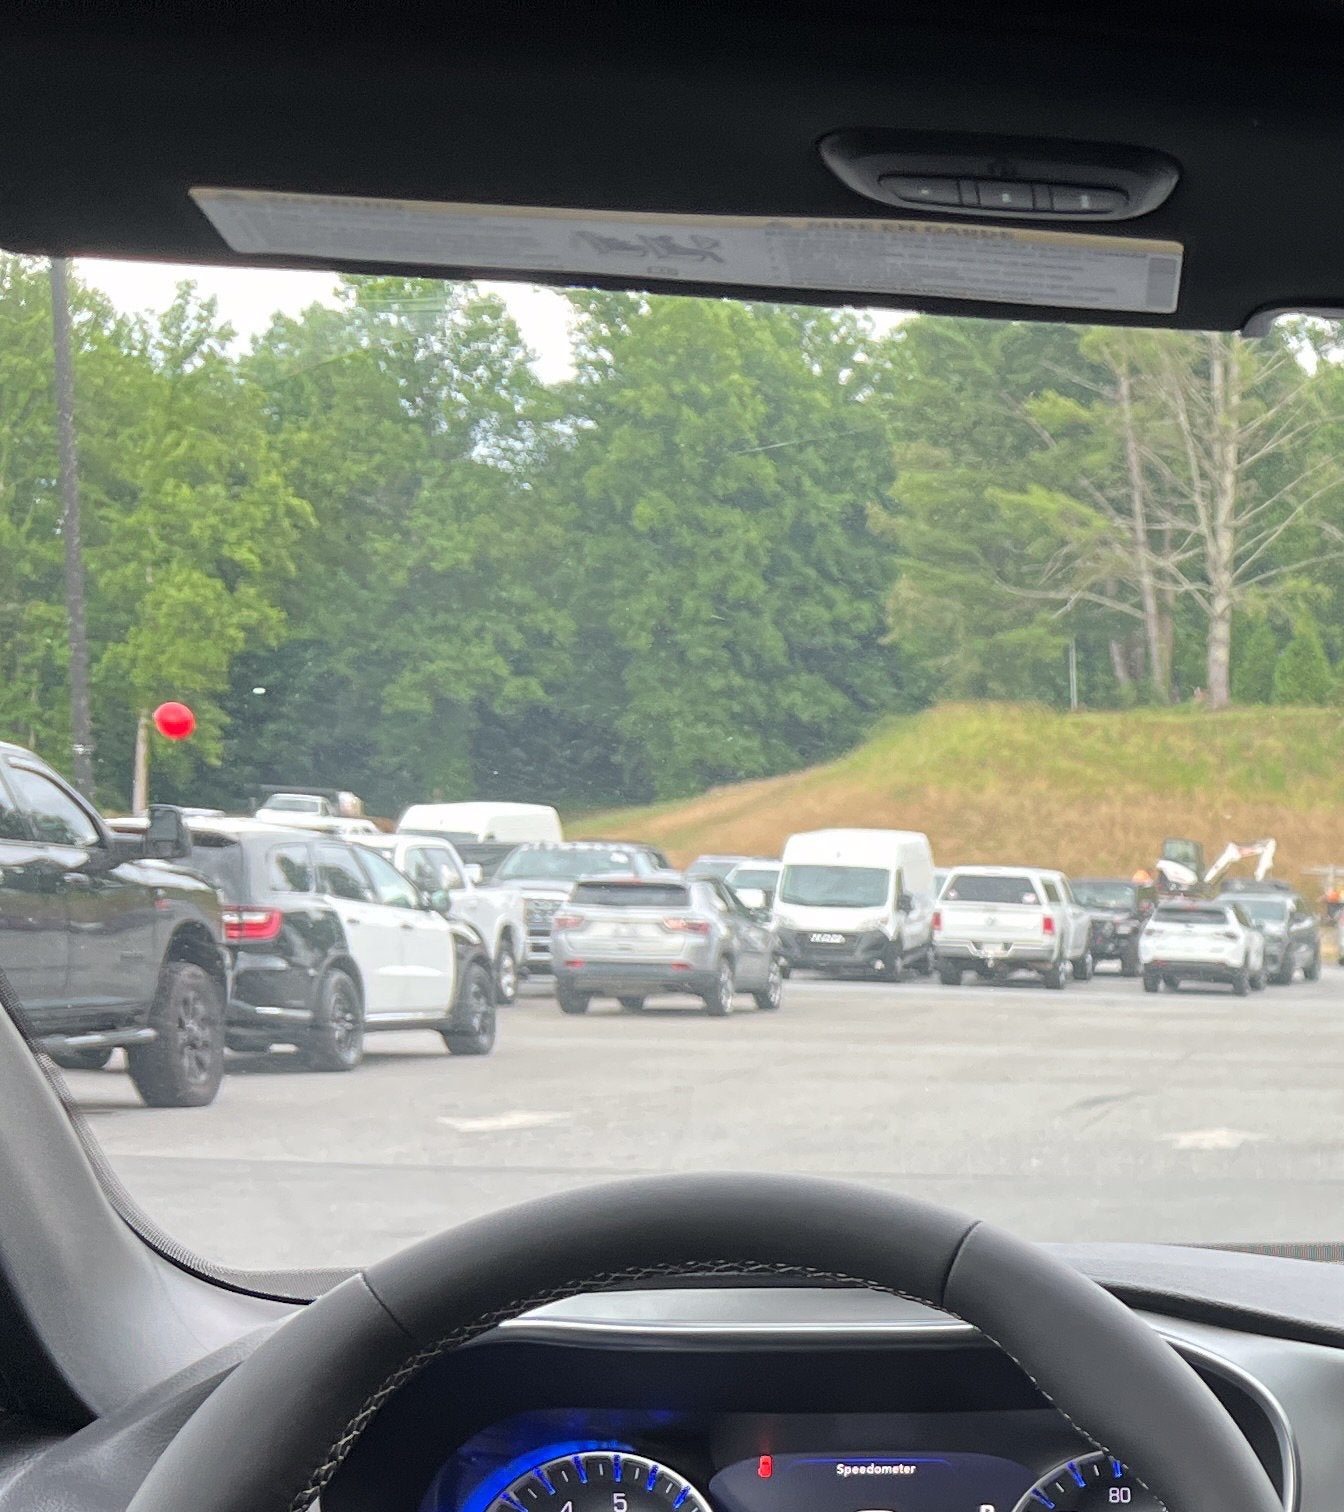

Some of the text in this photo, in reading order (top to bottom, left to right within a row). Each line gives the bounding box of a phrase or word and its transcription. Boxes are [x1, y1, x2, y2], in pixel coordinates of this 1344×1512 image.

[836, 1463, 916, 1477] Speedometer
[613, 1493, 627, 1512] 5
[1109, 1487, 1131, 1503] 80
